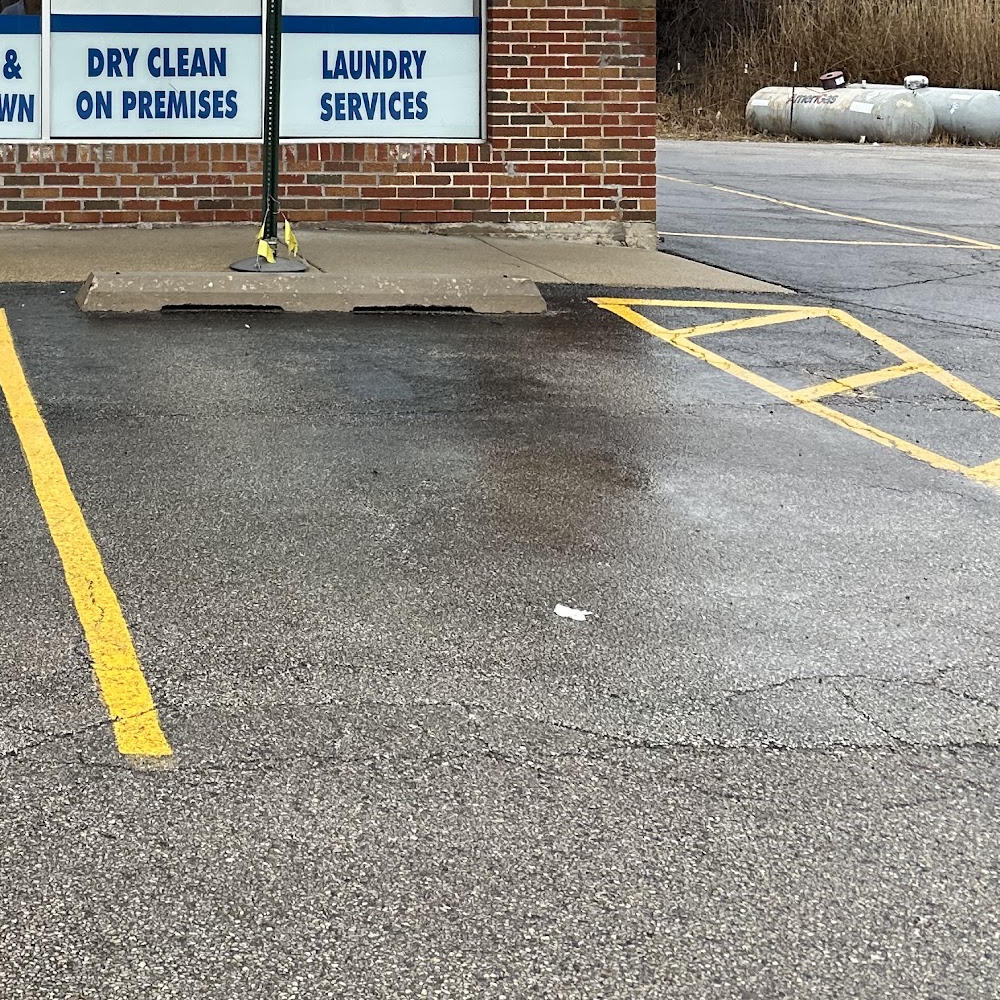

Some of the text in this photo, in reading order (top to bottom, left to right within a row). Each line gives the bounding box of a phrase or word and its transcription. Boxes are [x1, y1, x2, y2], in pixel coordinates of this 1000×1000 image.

[3, 48, 23, 80] &
[87, 47, 227, 78] DRY CLEAN
[322, 50, 427, 80] LAUNDRY
[76, 89, 238, 120] ON PREMISES
[320, 90, 429, 121] SERVICES
